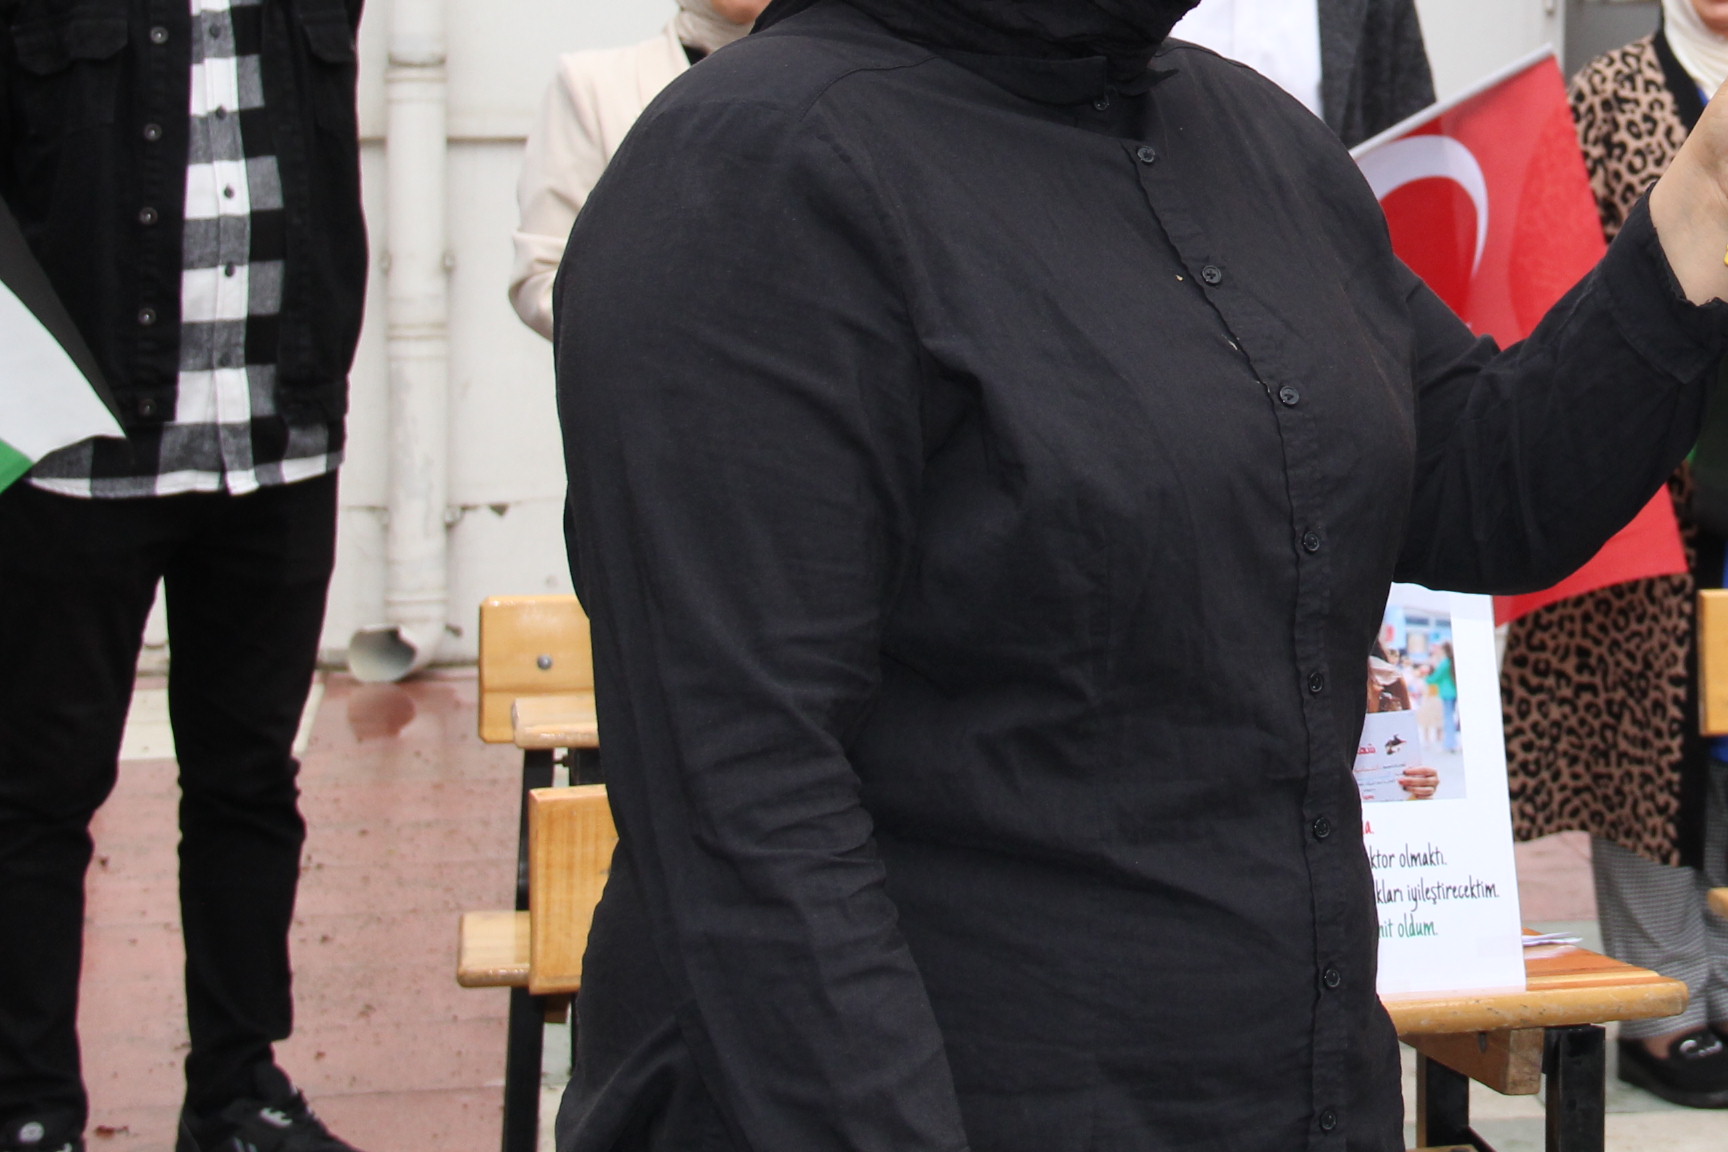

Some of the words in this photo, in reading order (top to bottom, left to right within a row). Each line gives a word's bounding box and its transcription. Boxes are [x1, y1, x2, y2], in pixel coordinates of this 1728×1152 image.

[1369, 845, 1396, 870] ktor
[1375, 878, 1404, 904] kları
[1398, 913, 1439, 938] oldum.
